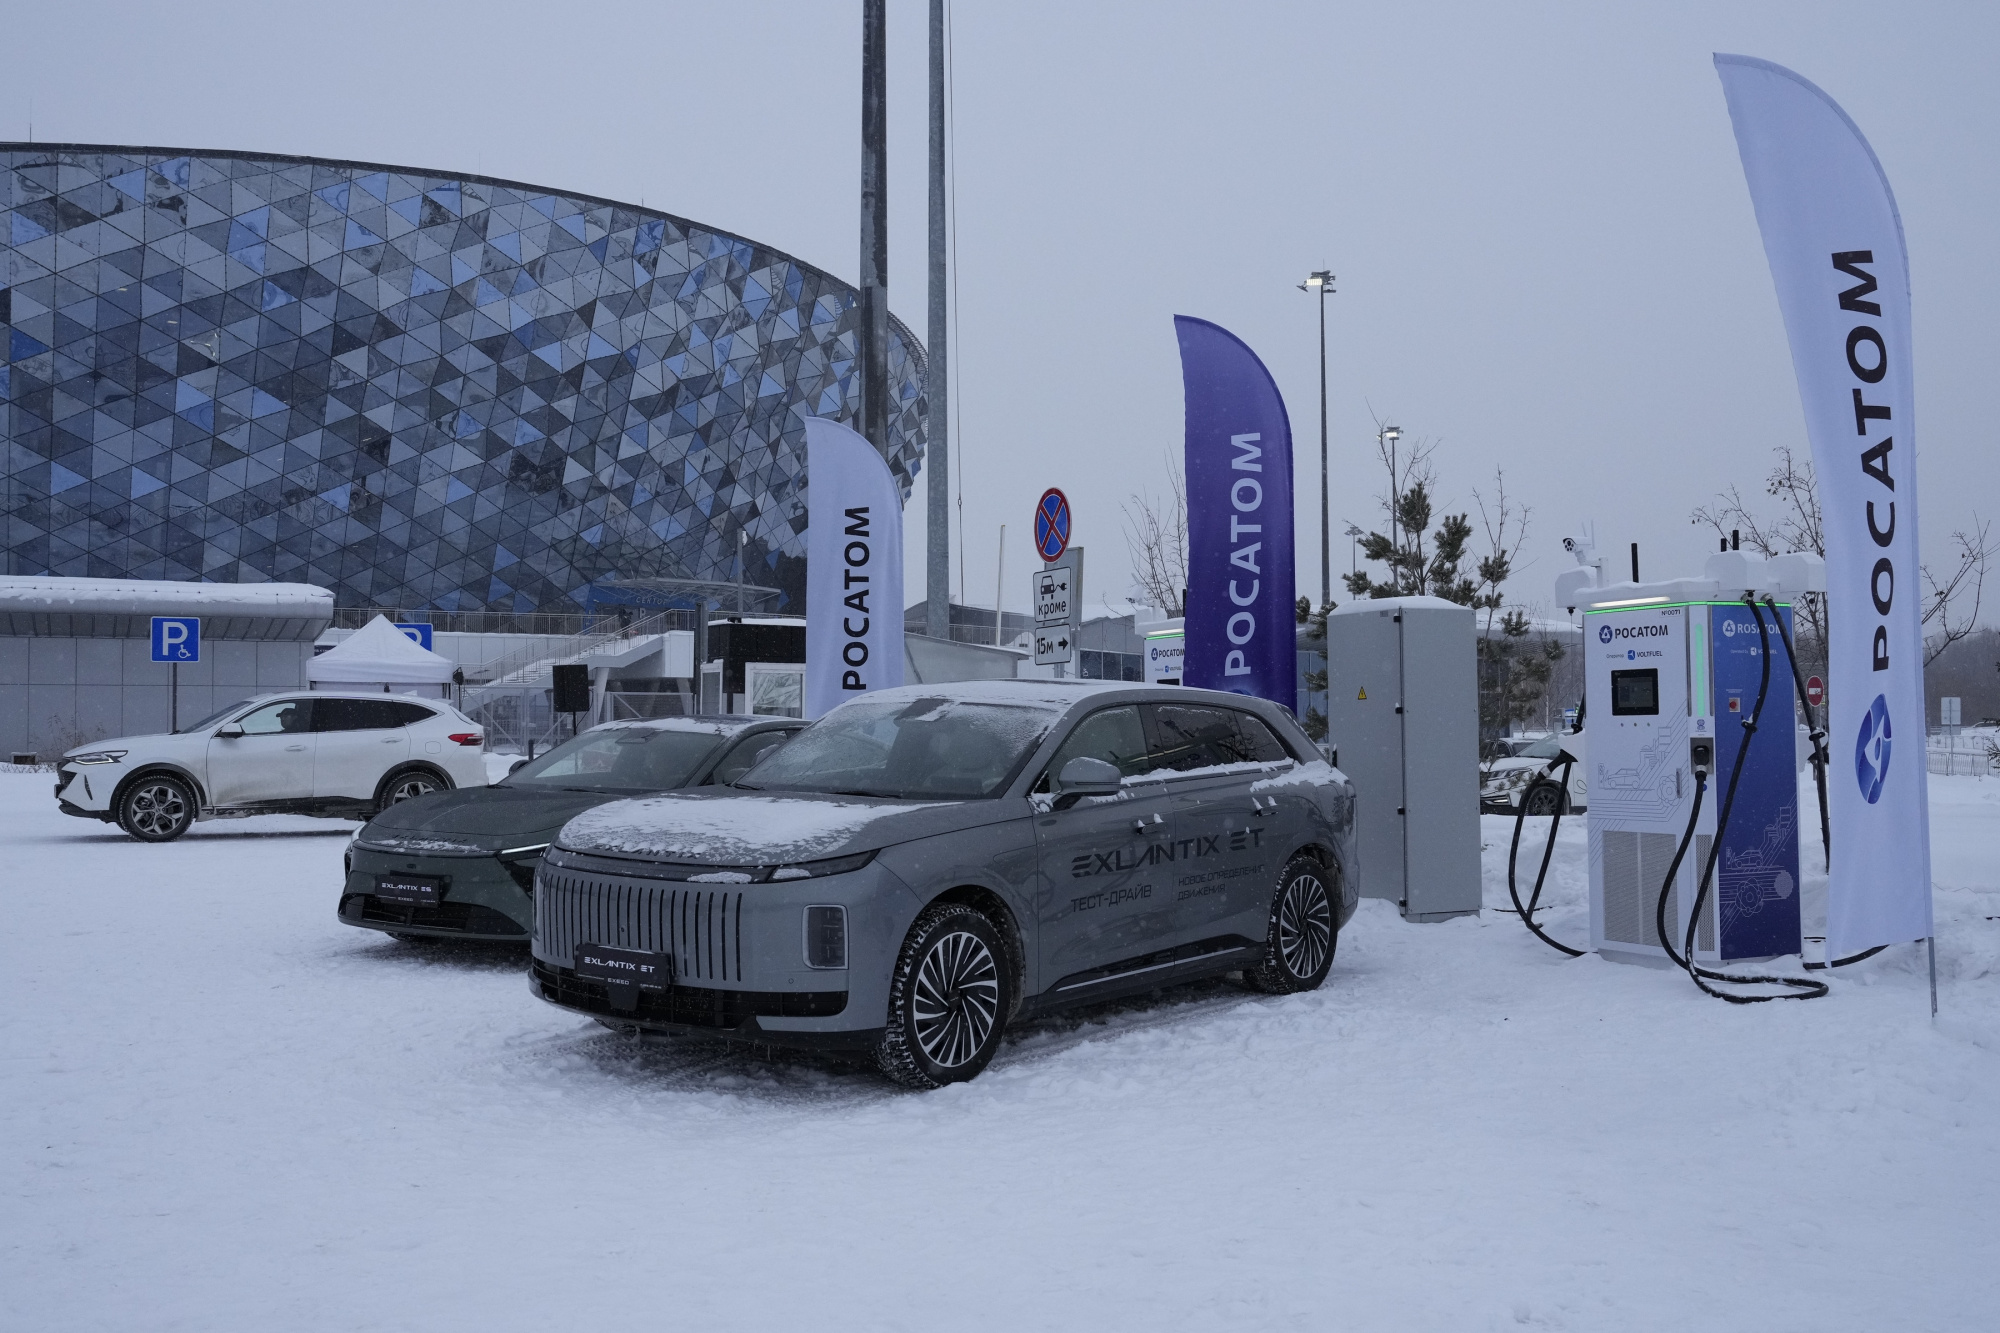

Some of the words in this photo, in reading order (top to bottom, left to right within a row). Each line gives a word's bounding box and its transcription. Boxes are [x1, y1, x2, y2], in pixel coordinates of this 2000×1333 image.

[1831, 250, 1896, 672] РОСАТОМ
[1224, 432, 1263, 677] РОСАТОМ
[842, 506, 870, 690] РОСАТОМ
[1039, 600, 1067, 619] кроме
[163, 621, 188, 656] P
[1614, 625, 1669, 639] РОСАТОМ
[1037, 637, 1054, 655] 15м
[1071, 834, 1221, 878] EXLANTIX
[1229, 827, 1266, 851] ET
[381, 882, 418, 891] EXLANTIX
[1178, 873, 1207, 887] НОВОЕ
[1071, 883, 1152, 913] ТЕСТ-ДРАЙВ
[1177, 883, 1226, 902] ДВИЖЕНИЯ
[584, 956, 636, 971] EXLANTIX
[640, 964, 655, 973] ET
[607, 977, 630, 986] EXEED
